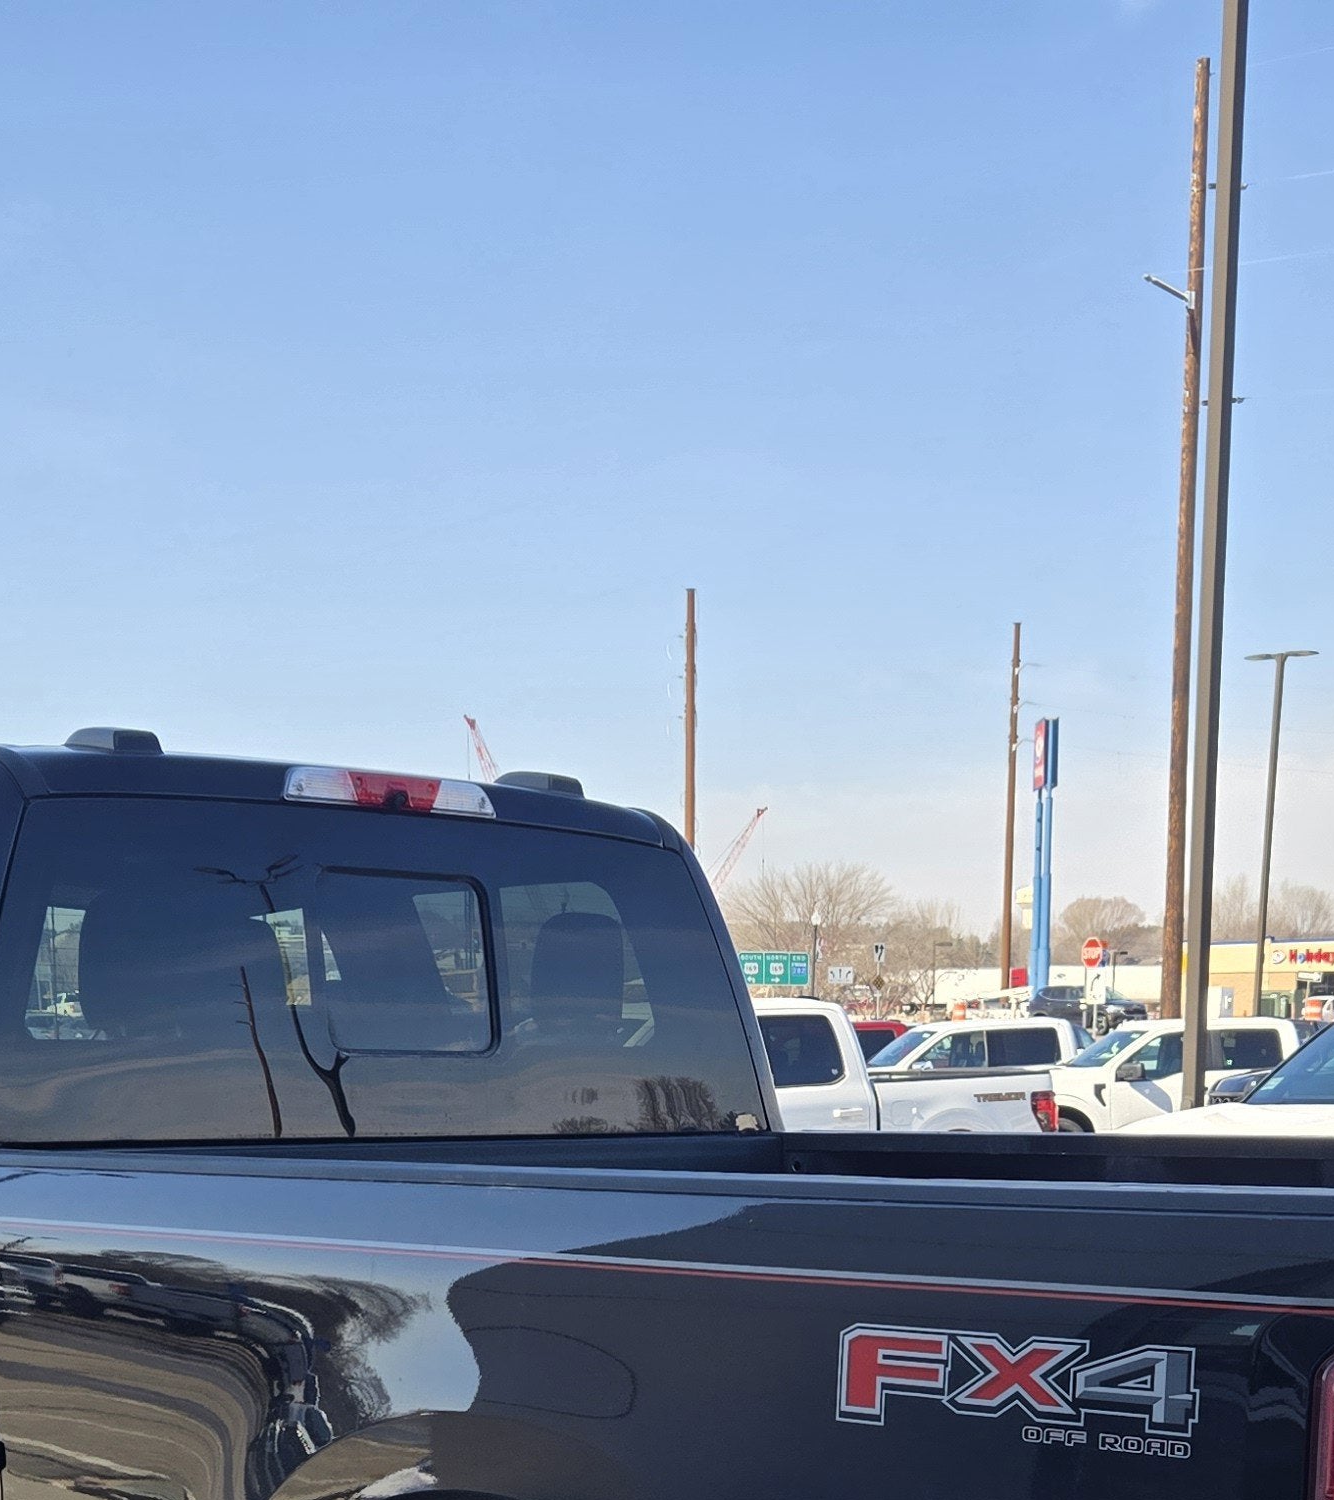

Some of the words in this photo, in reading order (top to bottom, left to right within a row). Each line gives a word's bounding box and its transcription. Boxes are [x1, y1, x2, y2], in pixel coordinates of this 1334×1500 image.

[1083, 947, 1102, 960] STOP
[974, 1091, 1026, 1102] TREMOR
[836, 1323, 1199, 1437] FX4
[1021, 1425, 1087, 1447] OFF
[1098, 1433, 1191, 1459] ROAD
